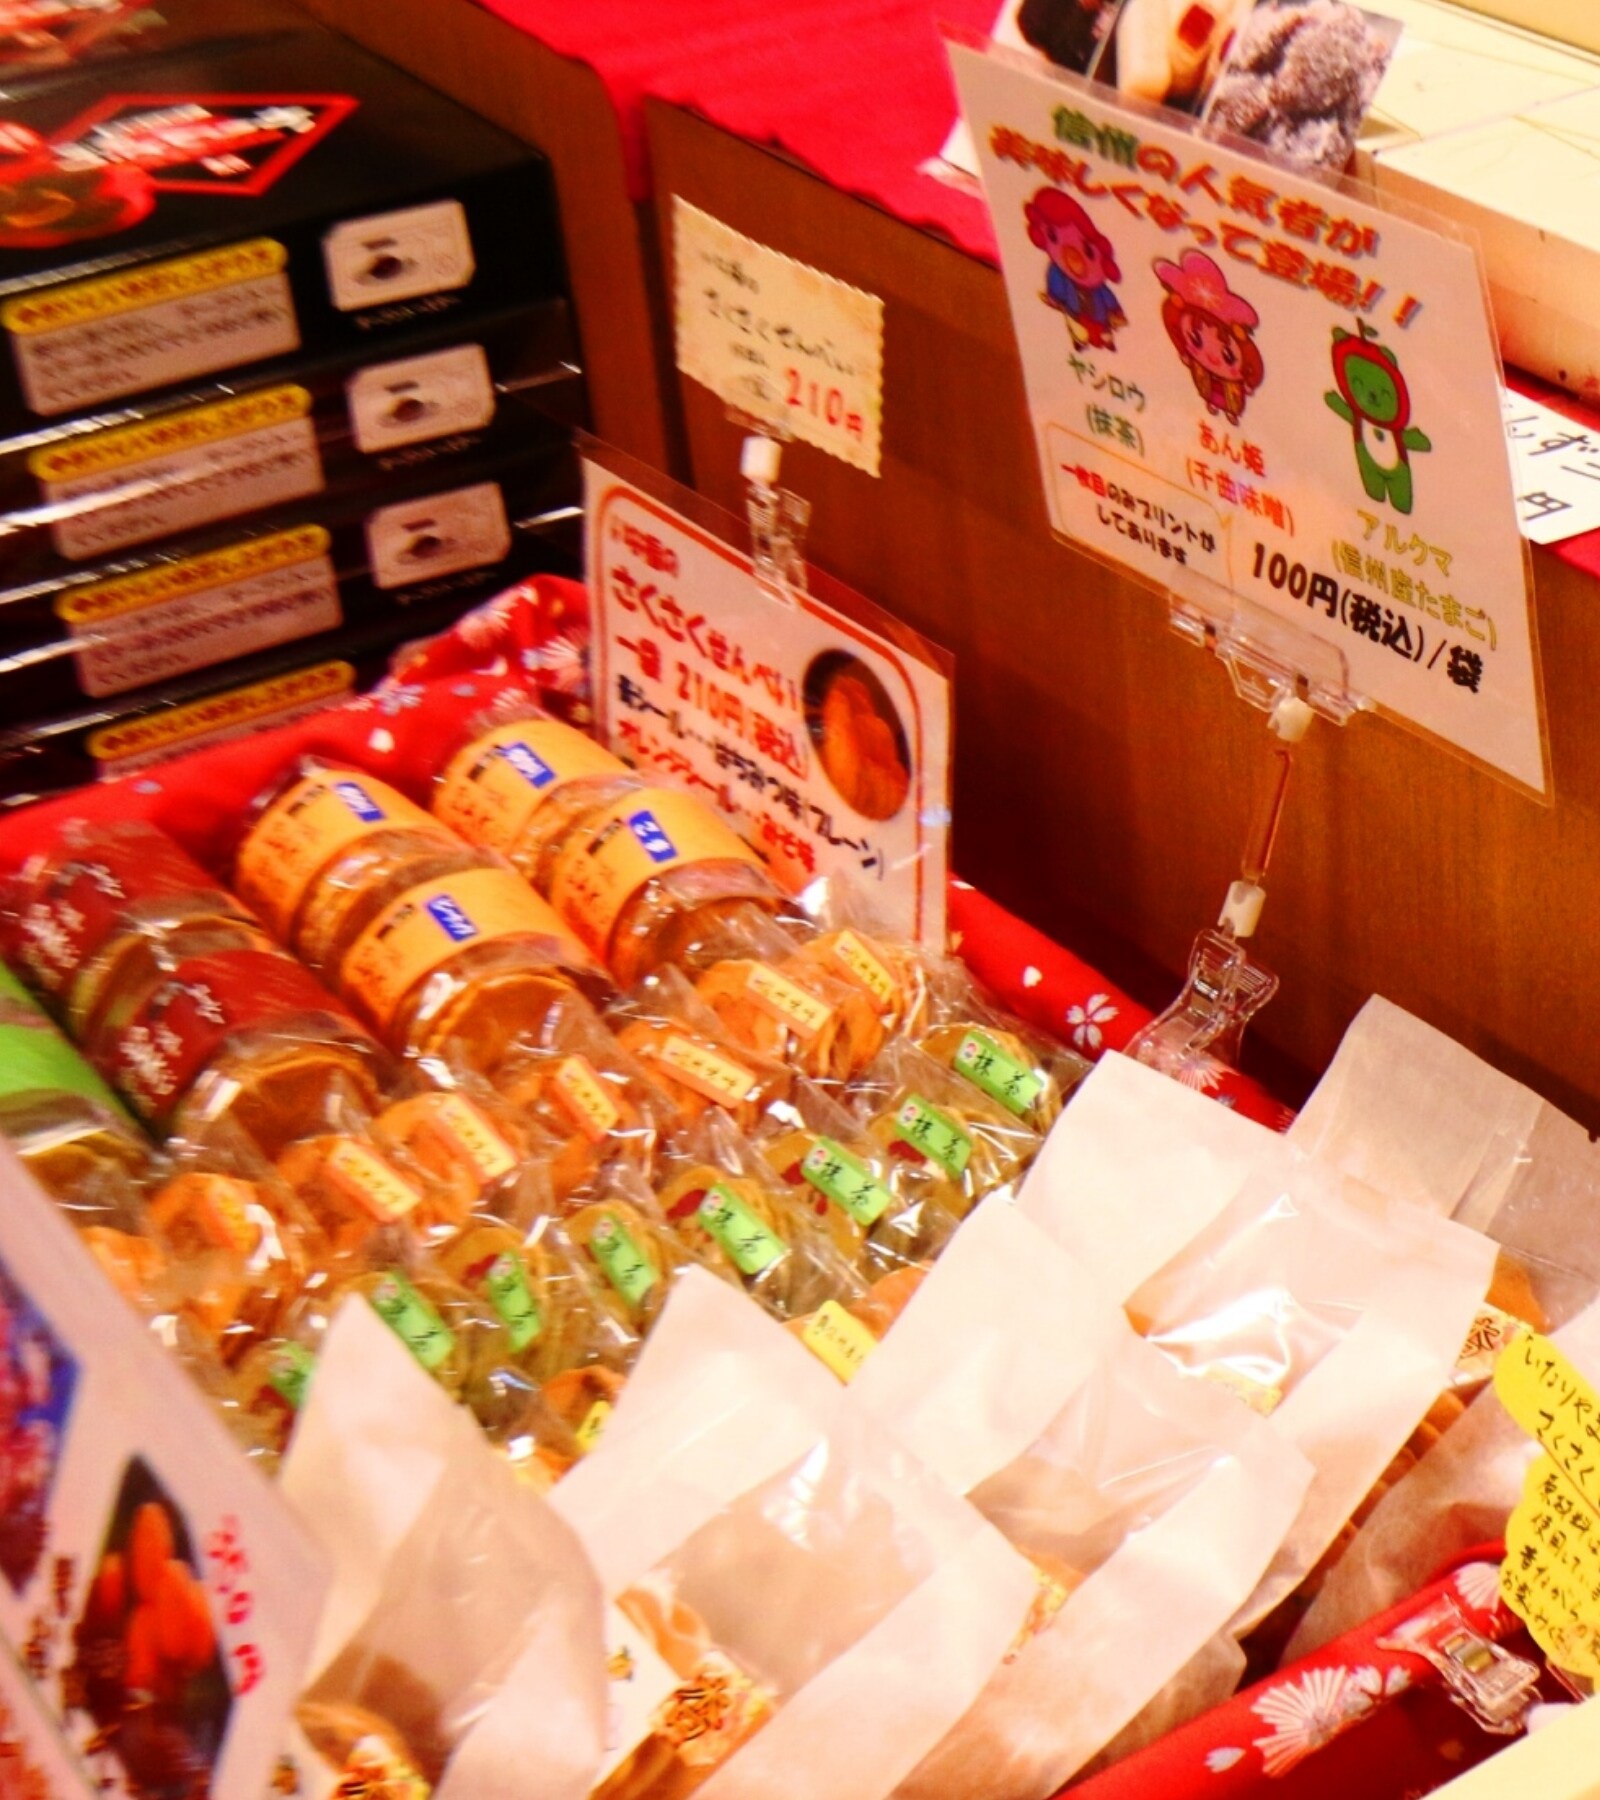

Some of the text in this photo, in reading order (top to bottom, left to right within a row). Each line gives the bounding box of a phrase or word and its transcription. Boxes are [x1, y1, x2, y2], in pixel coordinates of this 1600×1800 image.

[1052, 104, 1381, 258] 信州の人気者が
[1066, 351, 1146, 413] ヤシロウ
[1087, 407, 1145, 457] (抹茶)
[1199, 422, 1266, 478] あん姫
[1061, 462, 1216, 553] 一枚目のみプリントが
[1186, 457, 1295, 537] (千曲味噌)
[1097, 505, 1188, 566] してあります
[1357, 509, 1454, 577] アルクマ
[1331, 540, 1498, 651] (信州産たまご)
